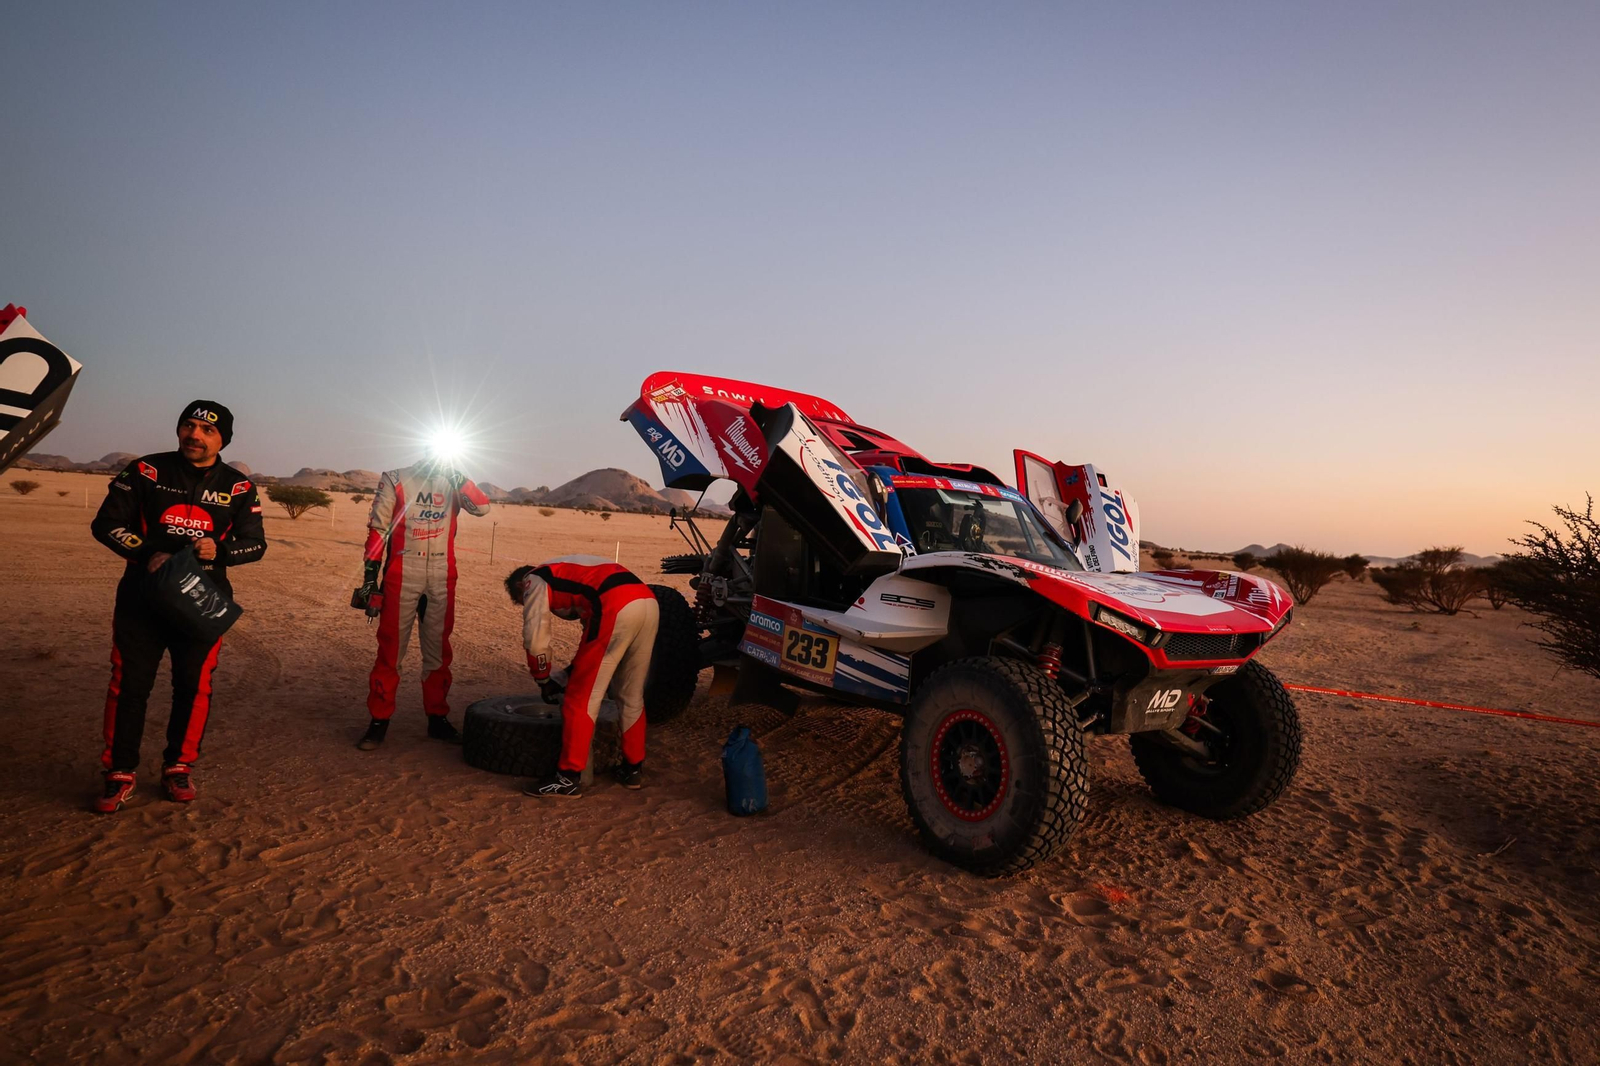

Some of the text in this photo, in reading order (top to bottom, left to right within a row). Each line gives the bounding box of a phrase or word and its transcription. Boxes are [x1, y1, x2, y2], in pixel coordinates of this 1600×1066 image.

[193, 408, 218, 423] MD
[724, 415, 763, 469] Milwaukee
[658, 438, 687, 468] MD
[201, 489, 232, 504] MD
[416, 491, 445, 505] MD
[821, 458, 896, 550] IGOL
[165, 514, 211, 529] SPORT
[166, 524, 205, 538] 2000
[1099, 491, 1131, 561] IGOL
[109, 527, 143, 548] MD
[1088, 544, 1099, 566] DELFINO
[750, 613, 781, 631] aramco
[786, 630, 829, 668] 233
[1146, 689, 1182, 710] MD
